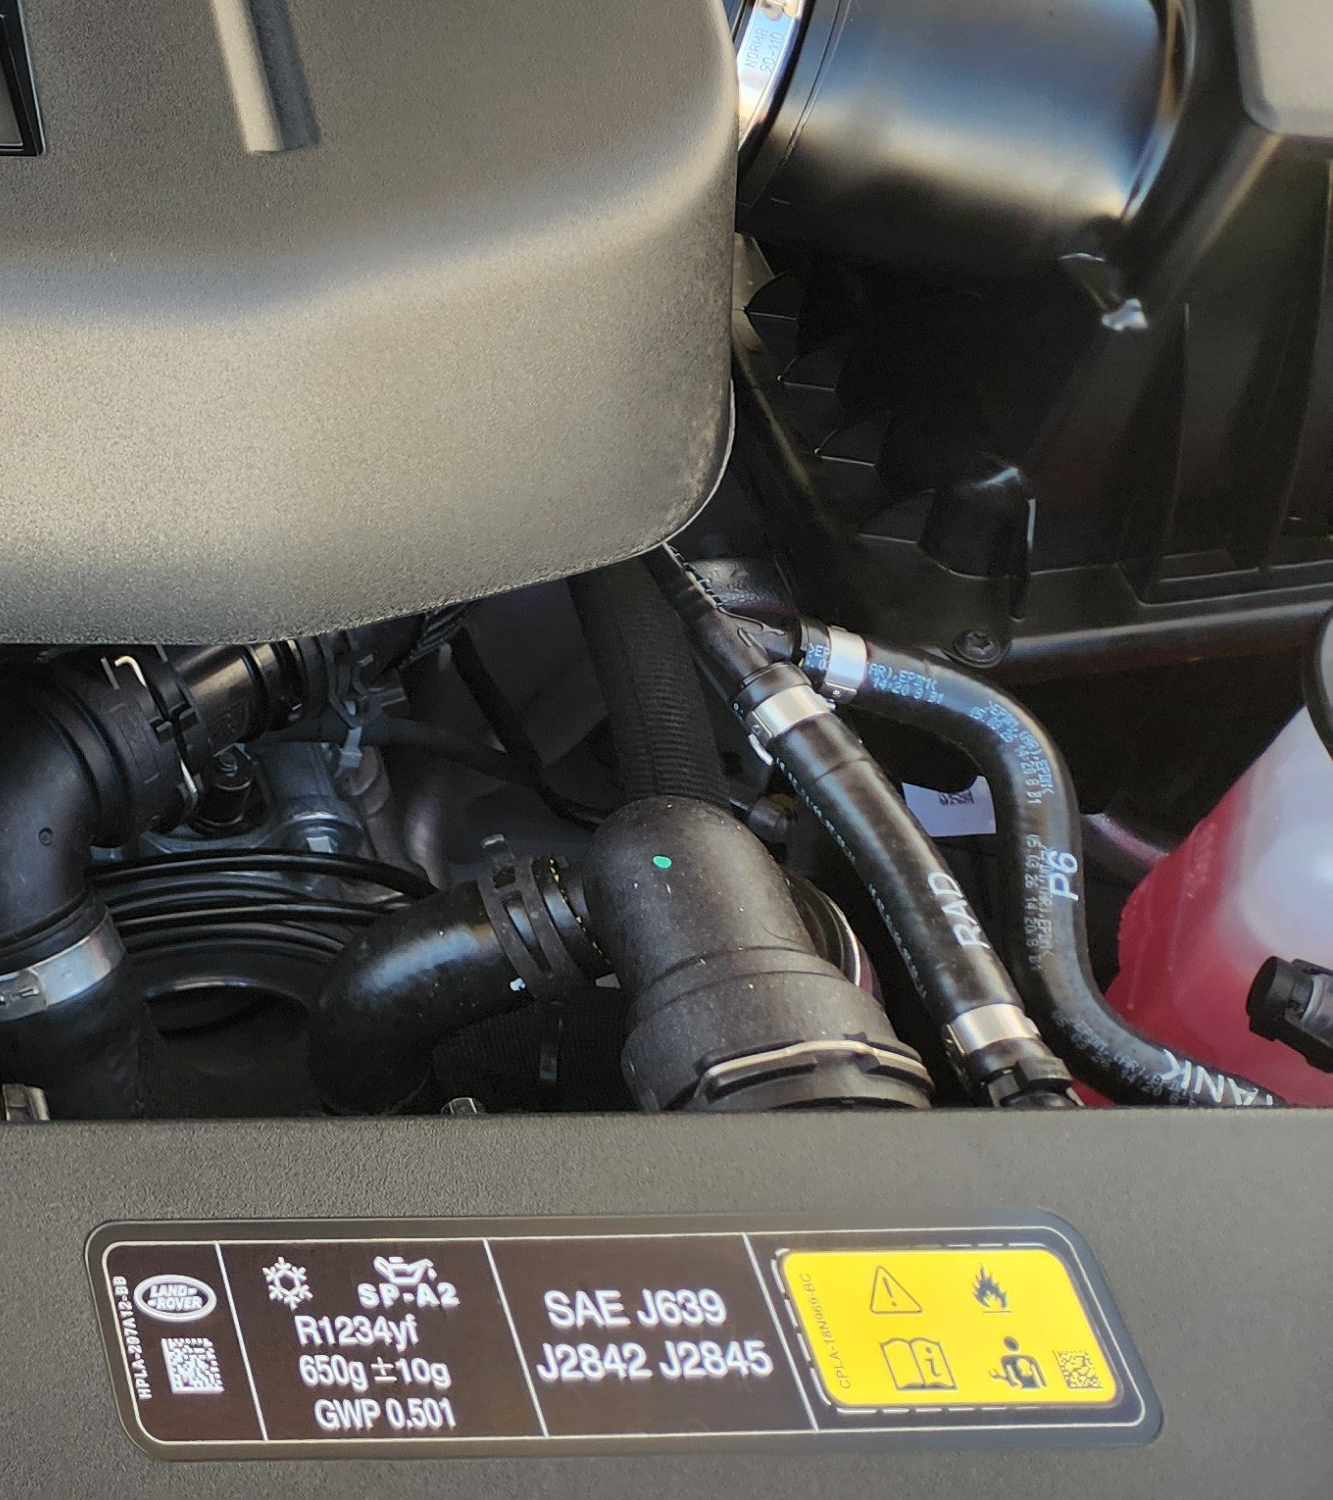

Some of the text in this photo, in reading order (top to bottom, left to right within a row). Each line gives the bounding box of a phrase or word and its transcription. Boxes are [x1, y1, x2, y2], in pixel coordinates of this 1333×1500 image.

[759, 32, 784, 75] 90-110
[1047, 851, 1079, 901] P6
[927, 871, 992, 951] RAD
[149, 1284, 190, 1299] LAND
[156, 1296, 203, 1311] ROVER
[358, 1282, 460, 1309] SP-A2
[543, 1288, 728, 1329] SAE J639
[294, 1313, 420, 1353] R1234yf
[299, 1354, 452, 1393] 650g ±10g
[536, 1339, 775, 1384] J2842 J2845
[314, 1397, 458, 1432] GWP 0.501
